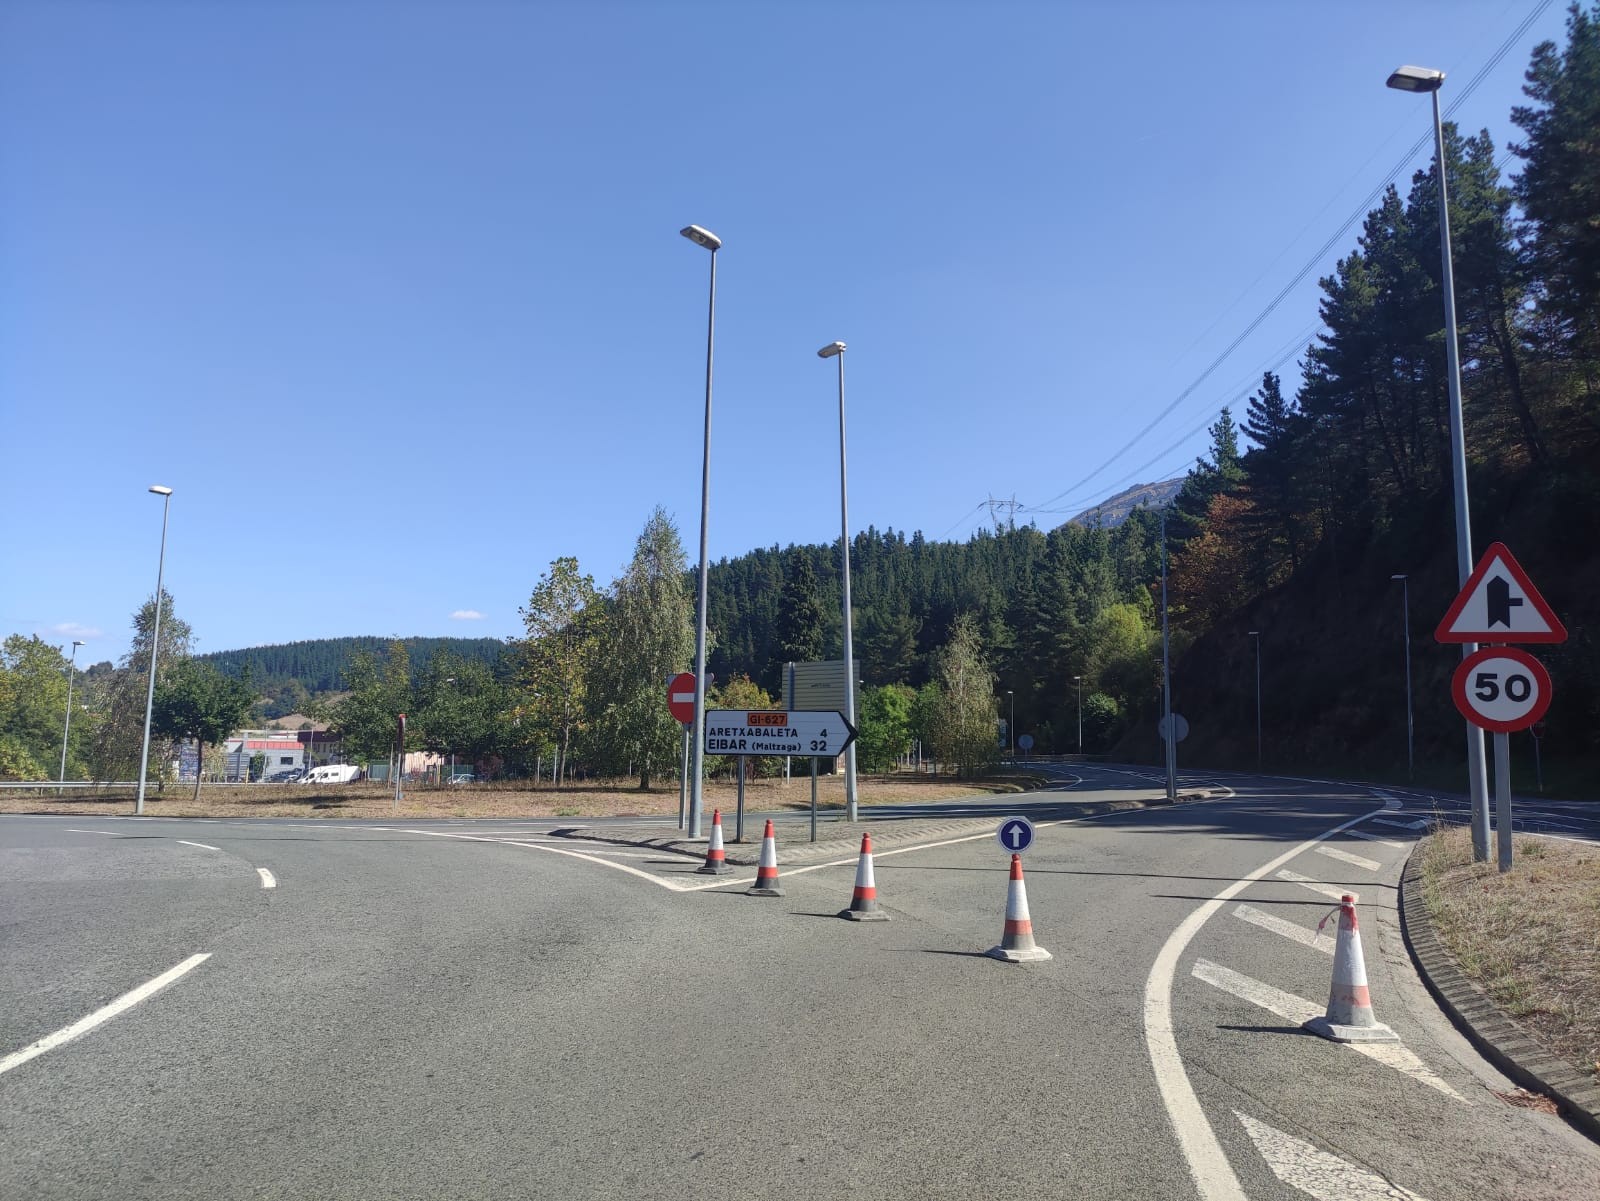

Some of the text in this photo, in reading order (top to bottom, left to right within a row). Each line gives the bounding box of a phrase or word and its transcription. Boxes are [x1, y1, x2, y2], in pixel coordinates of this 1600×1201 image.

[1475, 673, 1531, 702] 50
[750, 715, 785, 725] GI-627
[709, 728, 828, 738] ARETXABALETA 4
[708, 739, 827, 753] EIBAR (Maltzaga) 32
